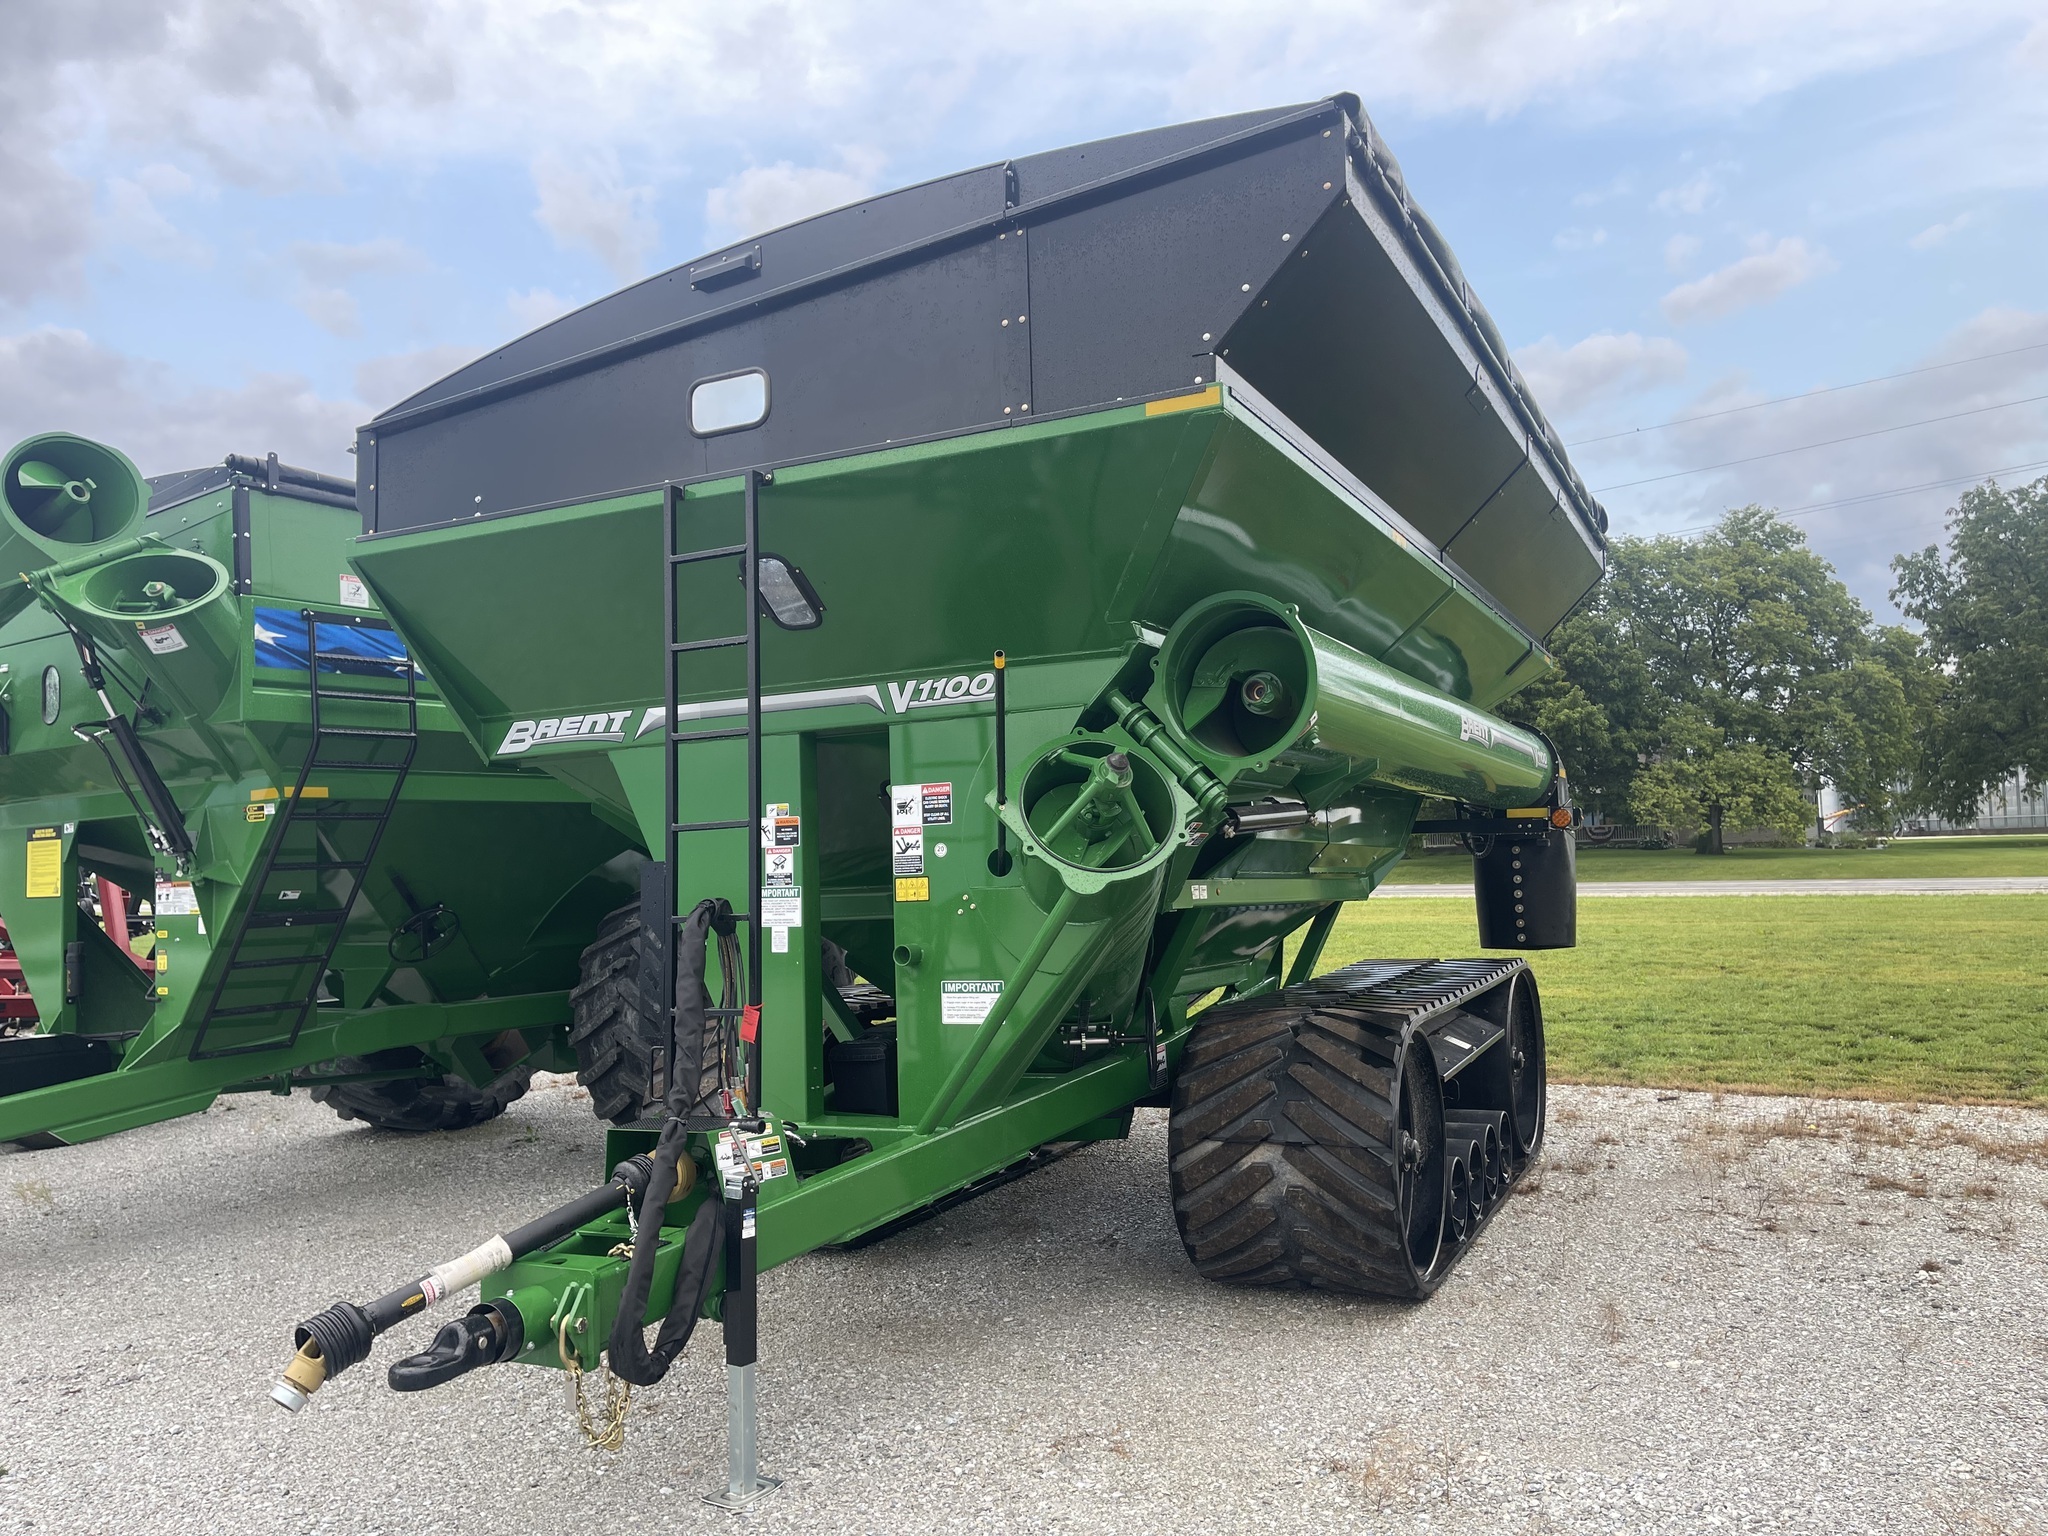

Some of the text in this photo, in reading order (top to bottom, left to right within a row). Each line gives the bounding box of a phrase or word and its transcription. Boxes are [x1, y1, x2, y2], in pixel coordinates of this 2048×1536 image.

[887, 673, 995, 714] V1100
[496, 710, 633, 755] BRENT
[1460, 715, 1489, 743] BRENT
[927, 785, 950, 793] DANGER
[761, 888, 799, 898] MPORTANT
[944, 983, 1000, 992] IMPORTANT
